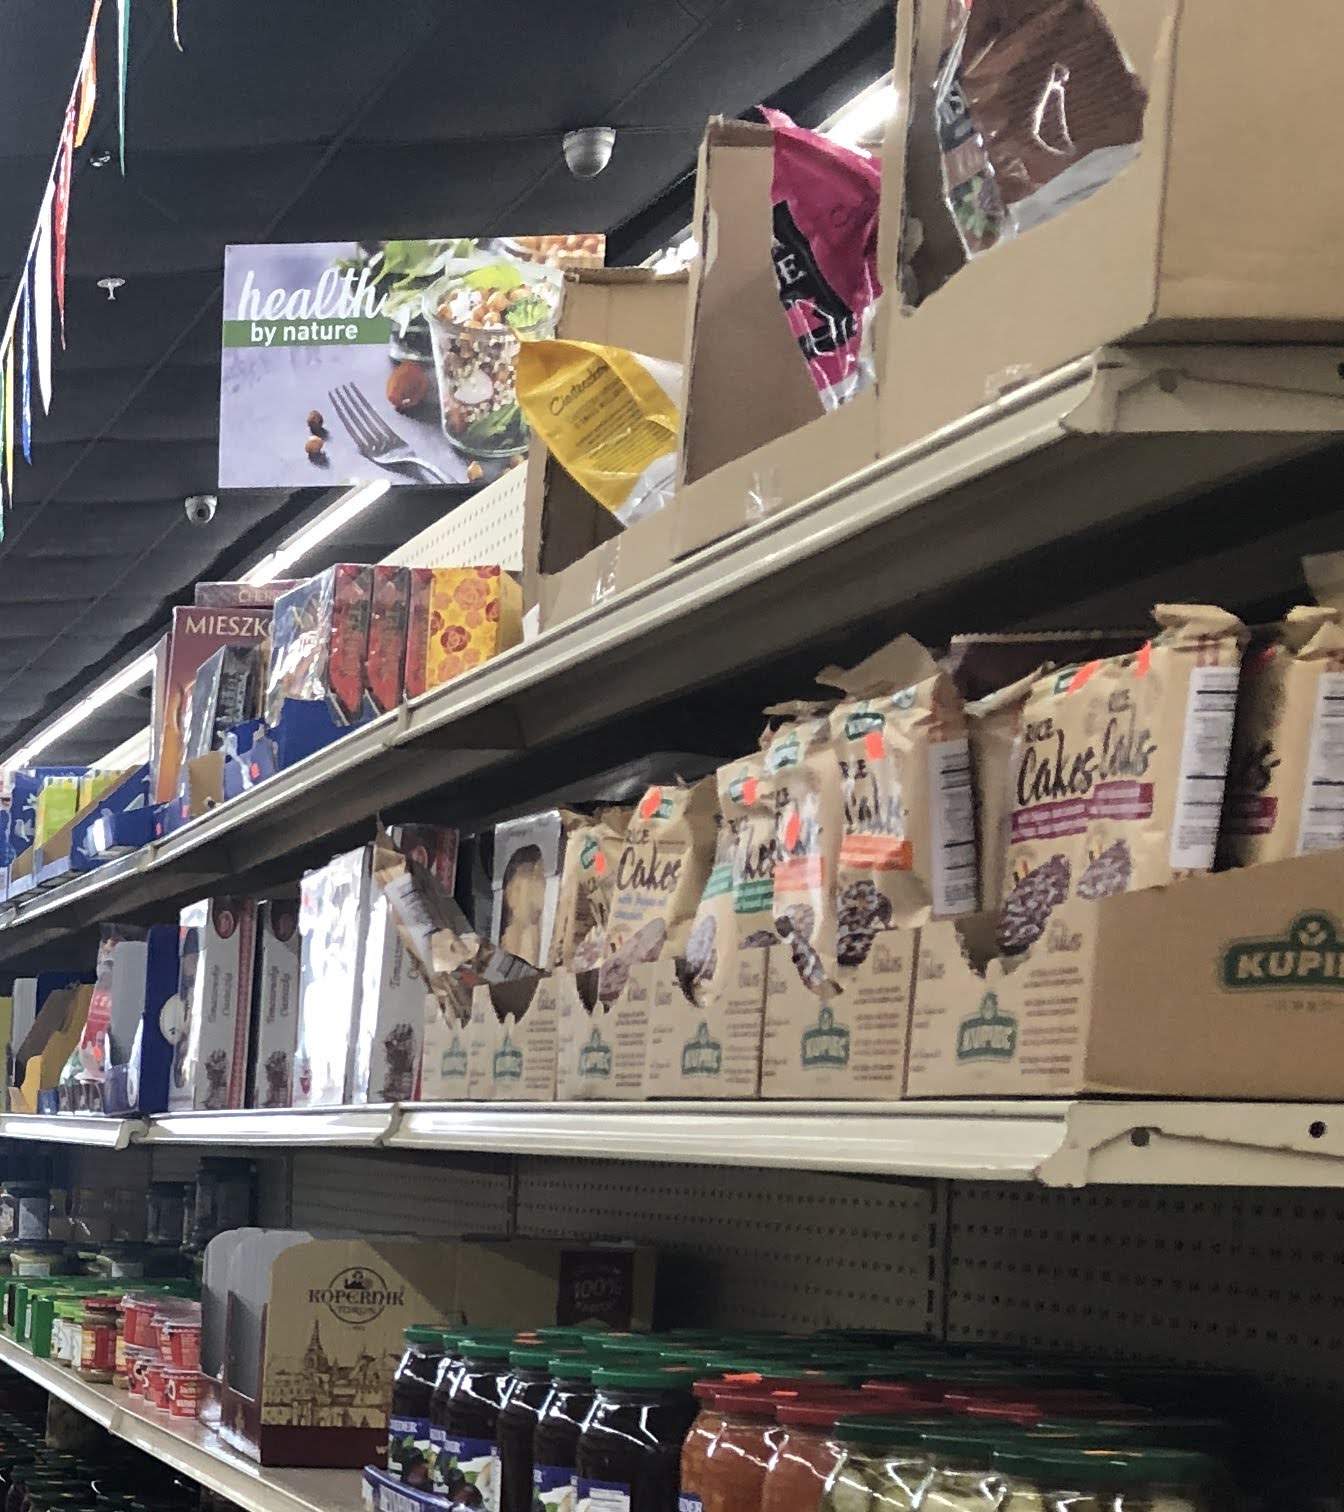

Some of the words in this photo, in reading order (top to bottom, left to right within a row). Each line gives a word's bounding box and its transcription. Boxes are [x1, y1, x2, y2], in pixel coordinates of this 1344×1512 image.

[251, 321, 278, 347] by
[283, 321, 358, 342] nature
[616, 840, 682, 891] Cakes
[1234, 950, 1344, 981] KUPI
[309, 1284, 405, 1307] KOPERNIK
